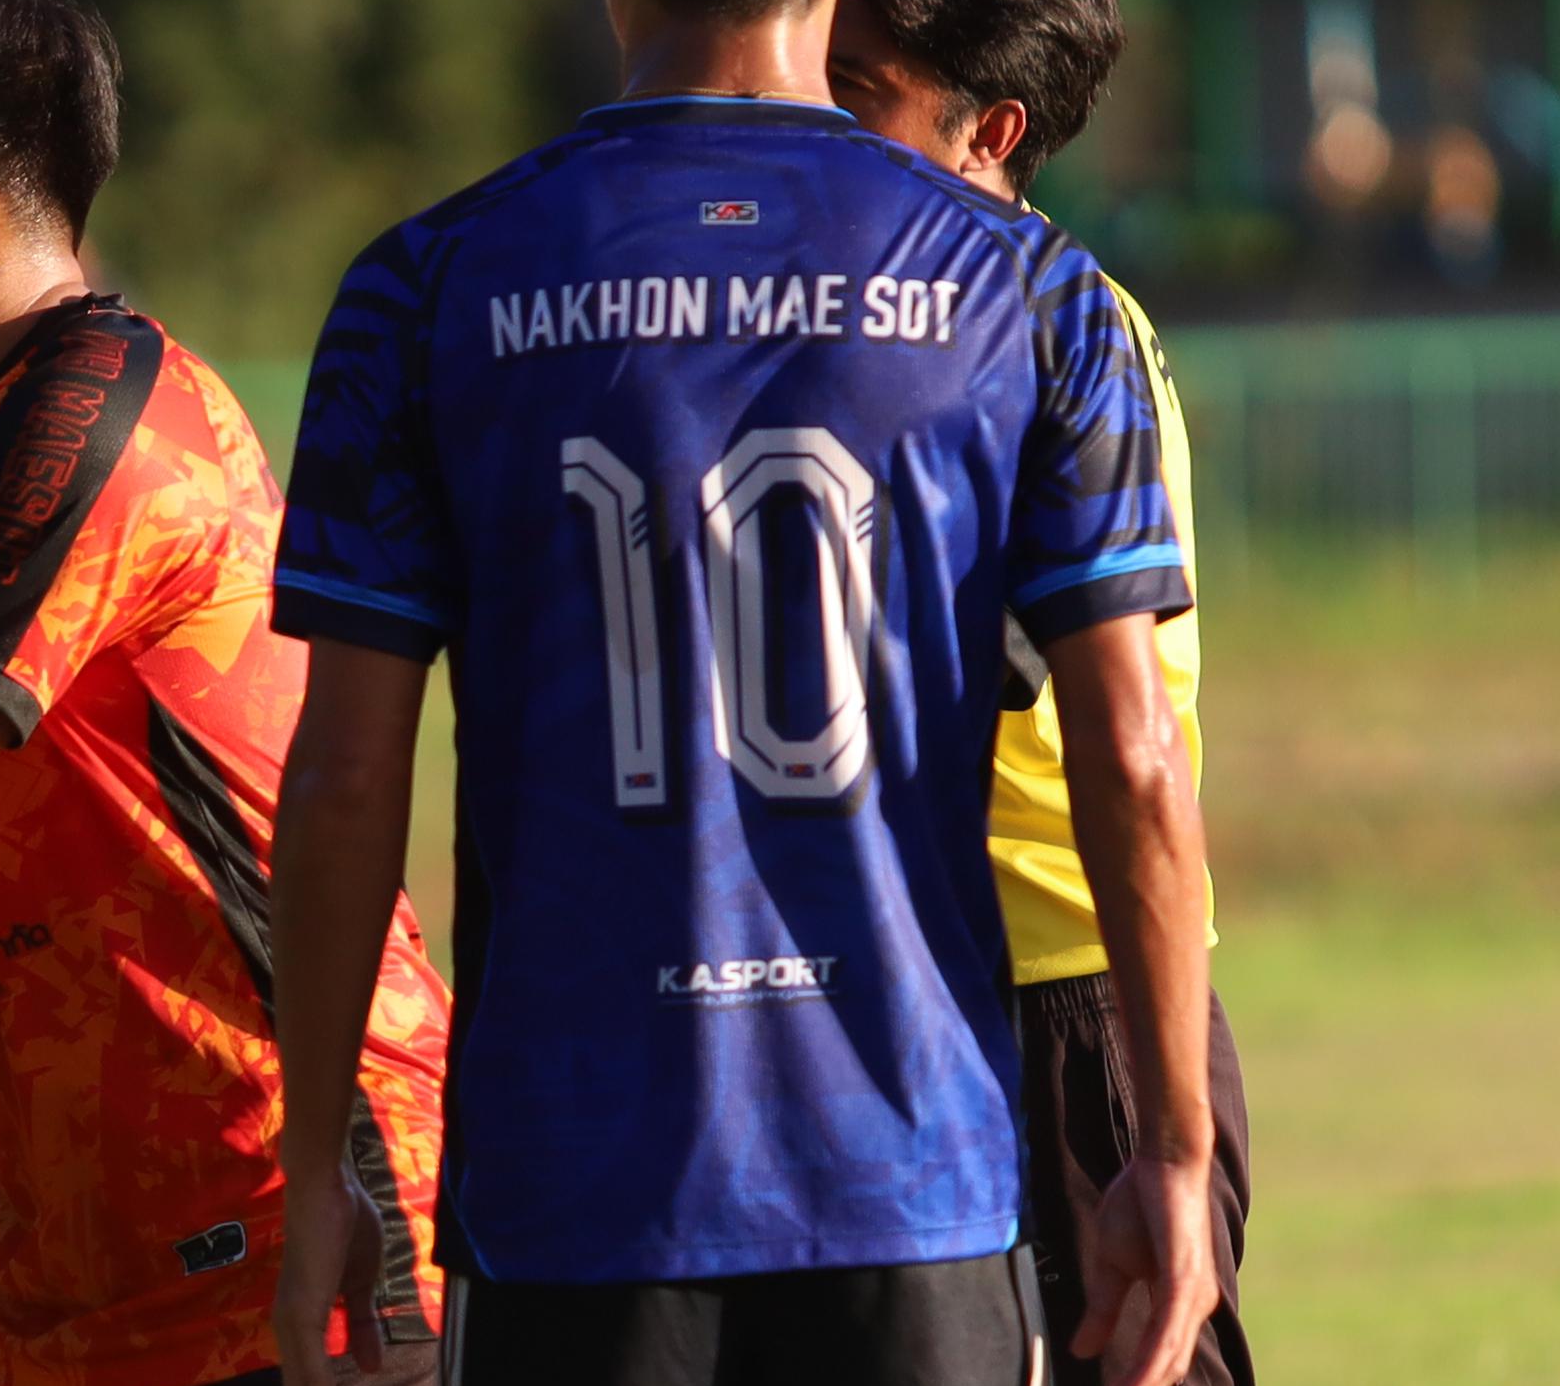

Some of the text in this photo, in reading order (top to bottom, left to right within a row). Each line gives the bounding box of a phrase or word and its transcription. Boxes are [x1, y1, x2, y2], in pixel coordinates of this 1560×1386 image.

[489, 274, 959, 357] NAKHON MAE SOT
[560, 427, 874, 807] 10
[657, 956, 837, 994] K.A.SPORT
